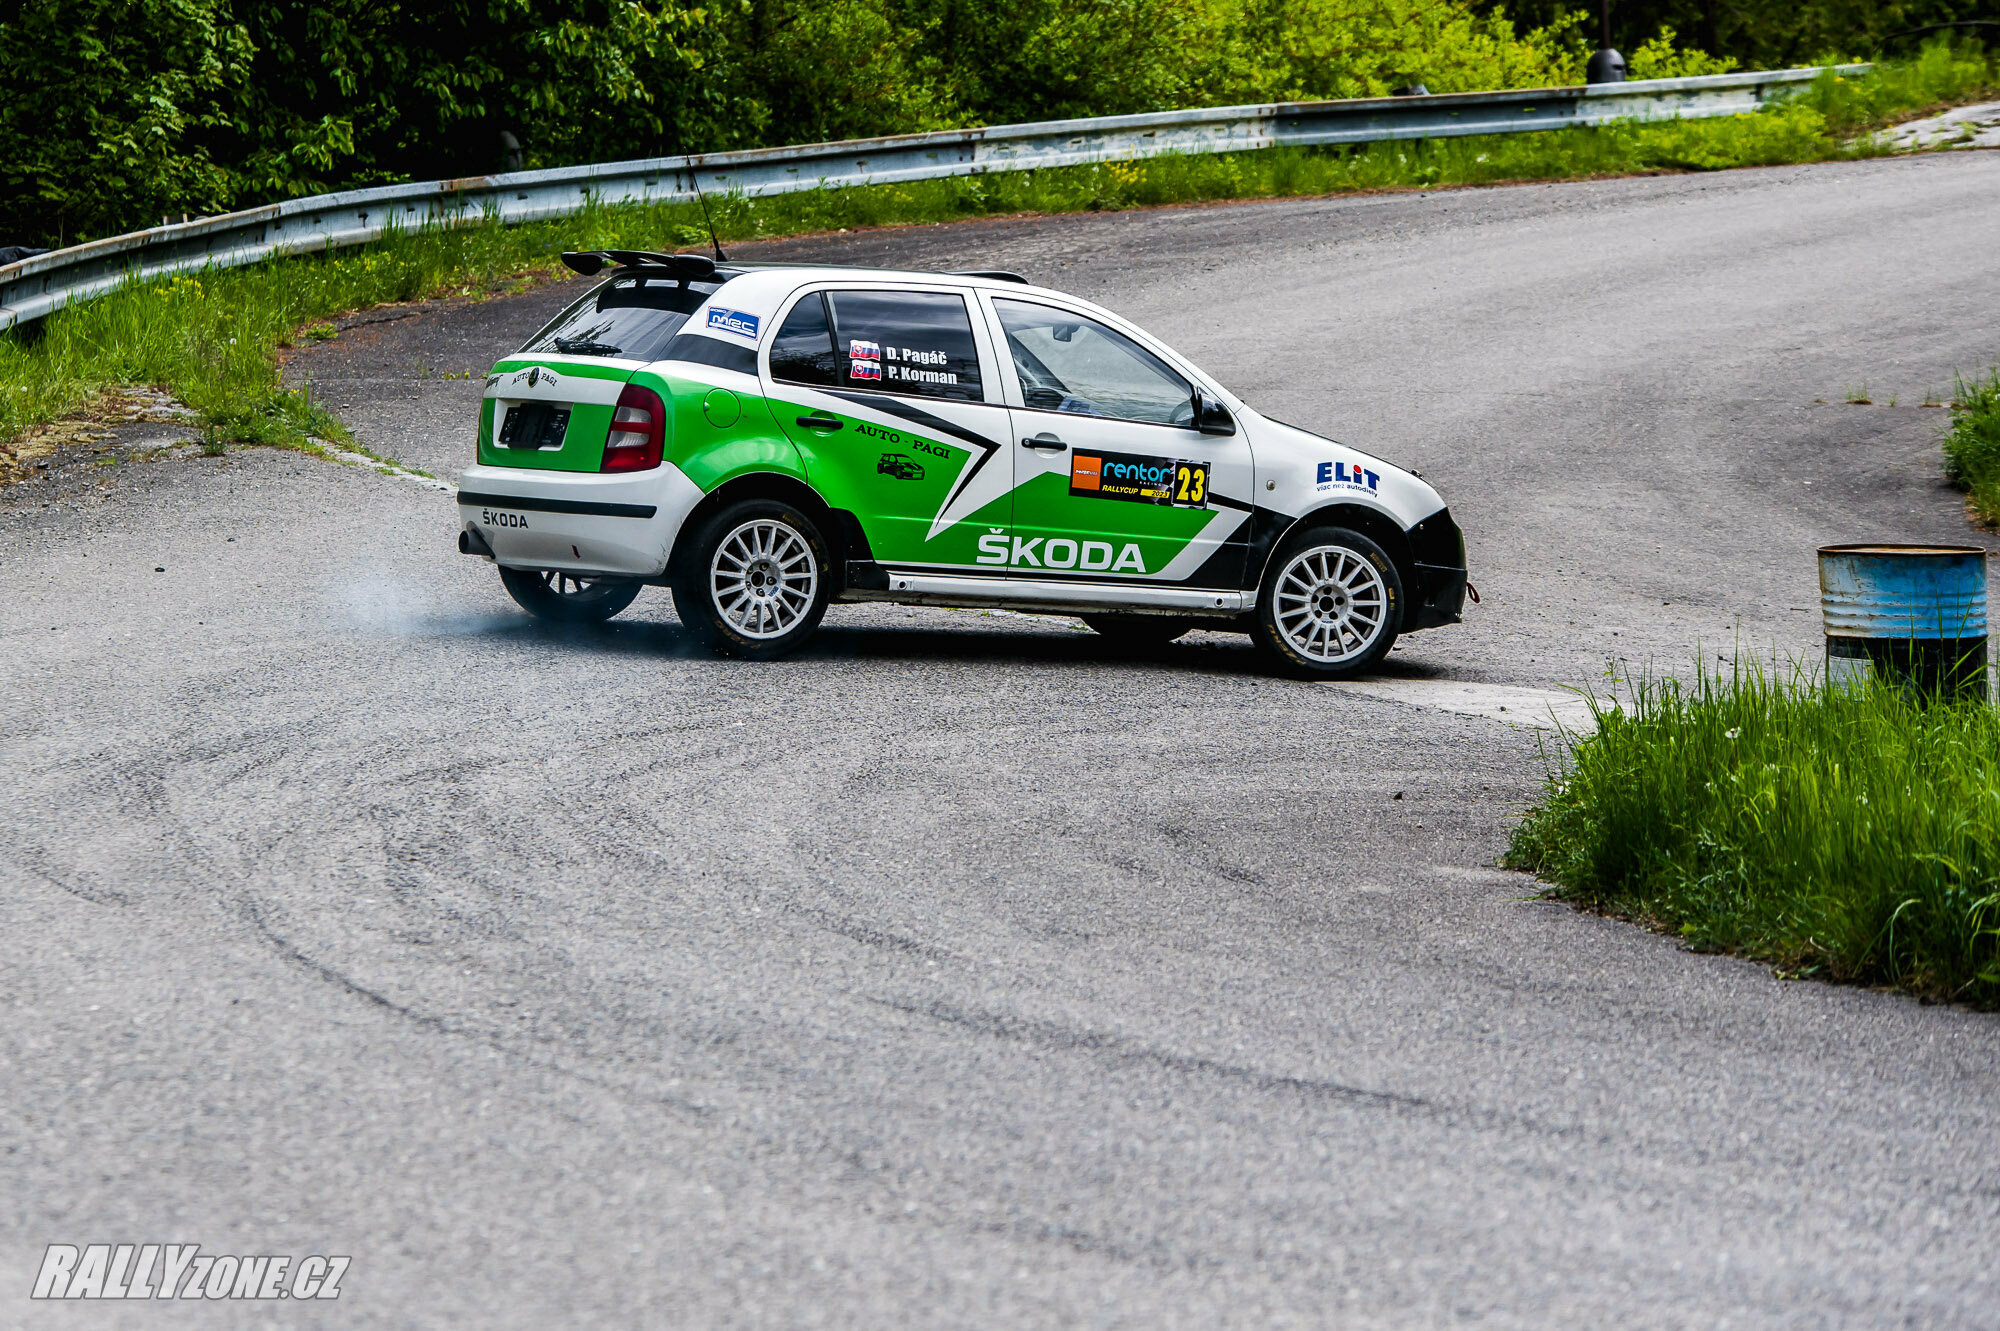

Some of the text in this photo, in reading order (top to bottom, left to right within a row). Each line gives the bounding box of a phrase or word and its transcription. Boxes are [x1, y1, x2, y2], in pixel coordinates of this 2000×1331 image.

[886, 346, 947, 364] D. Pagáč
[512, 372, 530, 385] AUTO
[541, 373, 557, 387] PAGI
[888, 366, 957, 384] P. Korman
[855, 423, 900, 443] AUTO
[913, 439, 950, 459] PAGI
[1103, 462, 1171, 482] rentor
[1102, 484, 1168, 498] RALLYCUP 2023
[1176, 467, 1205, 501] 23
[482, 508, 529, 529] ŠKODA
[976, 528, 1146, 573] ŠKODA
